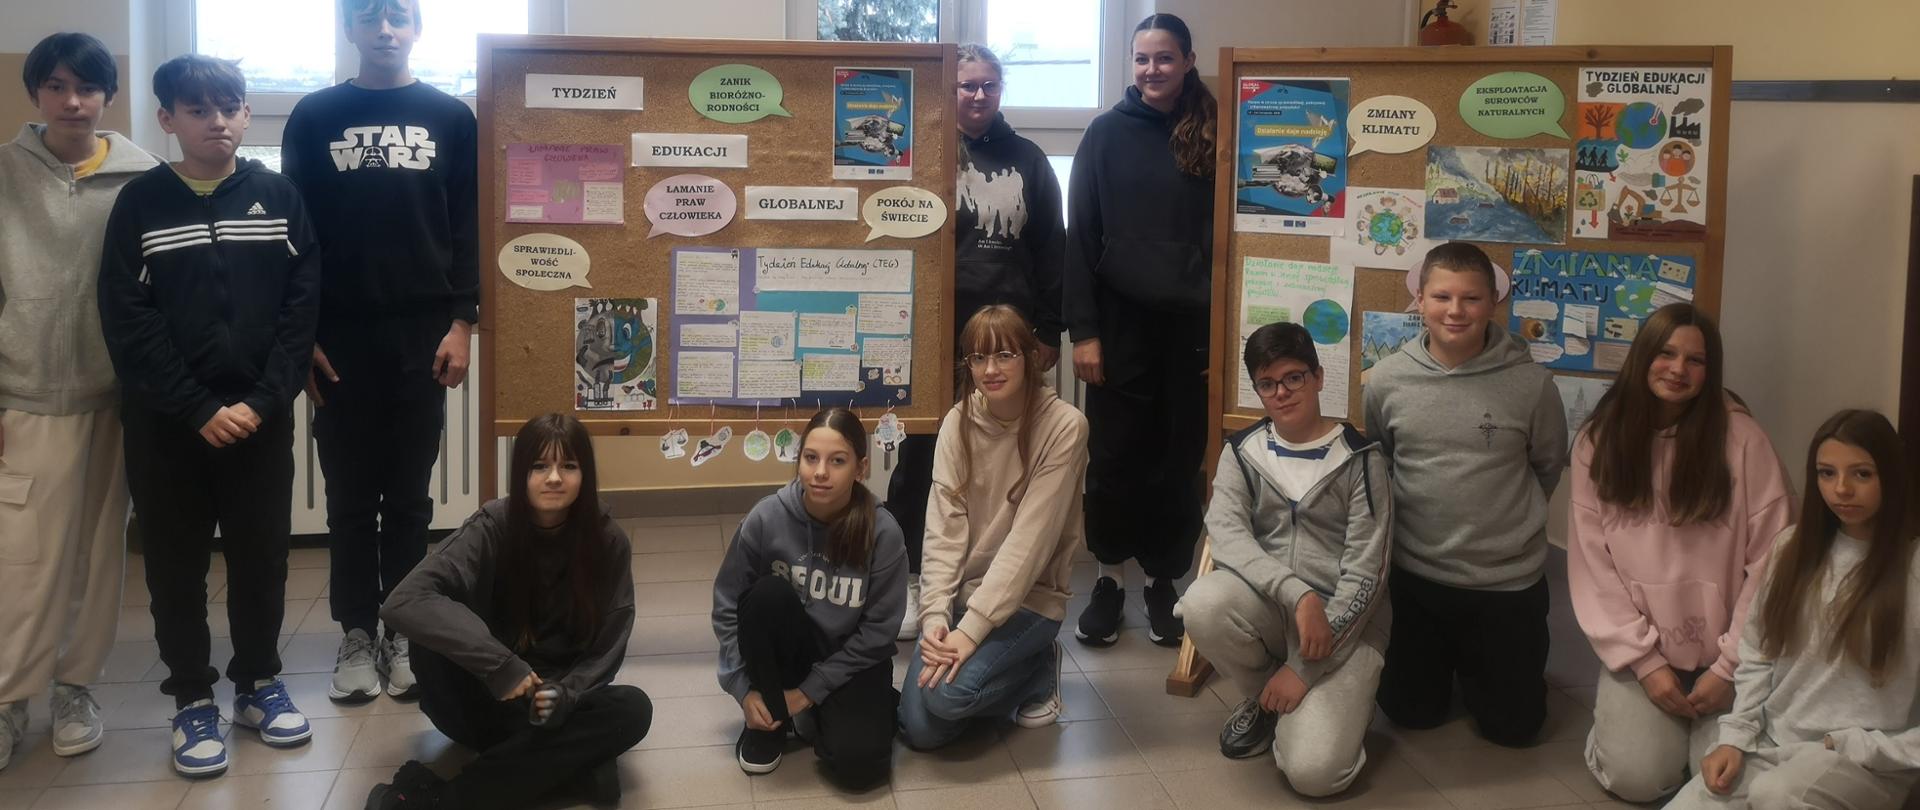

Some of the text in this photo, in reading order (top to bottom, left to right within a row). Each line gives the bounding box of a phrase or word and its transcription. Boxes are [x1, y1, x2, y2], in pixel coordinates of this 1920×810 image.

[720, 78, 751, 86] ZANIK
[1587, 70, 1706, 84] TYDZIEŃ EDUKACJI
[552, 87, 617, 100] TYDZIEŃ
[710, 89, 766, 99] BIORÓŻNO-
[1476, 86, 1547, 95] EKSPLOATACJA
[1607, 83, 1680, 95] GLOBALNEJ
[1484, 96, 1538, 105] SUROWCÓW
[707, 102, 759, 112] RODNOŚCI
[1367, 109, 1417, 120] ZMIANY
[1478, 109, 1545, 117] NATURALNYCH
[1362, 124, 1421, 136] KLIMATU
[330, 126, 436, 149] STAR
[652, 145, 728, 157] EDUKACJI
[330, 147, 436, 172] WARS
[666, 185, 715, 193] ŁAMANIE
[675, 198, 706, 206] PRAW
[759, 198, 844, 210] GLOBALNEJ
[877, 197, 915, 208] POKÓJ
[659, 211, 722, 220] CZŁOWIEKA
[881, 211, 929, 223] ŚWIECIE
[513, 244, 576, 255] SPRAWIEDLI-
[530, 257, 559, 267] WOŚĆ
[1515, 250, 1658, 281] ZMIANA
[515, 269, 572, 279] SPOŁECZNA
[771, 560, 866, 608] SEOUL
